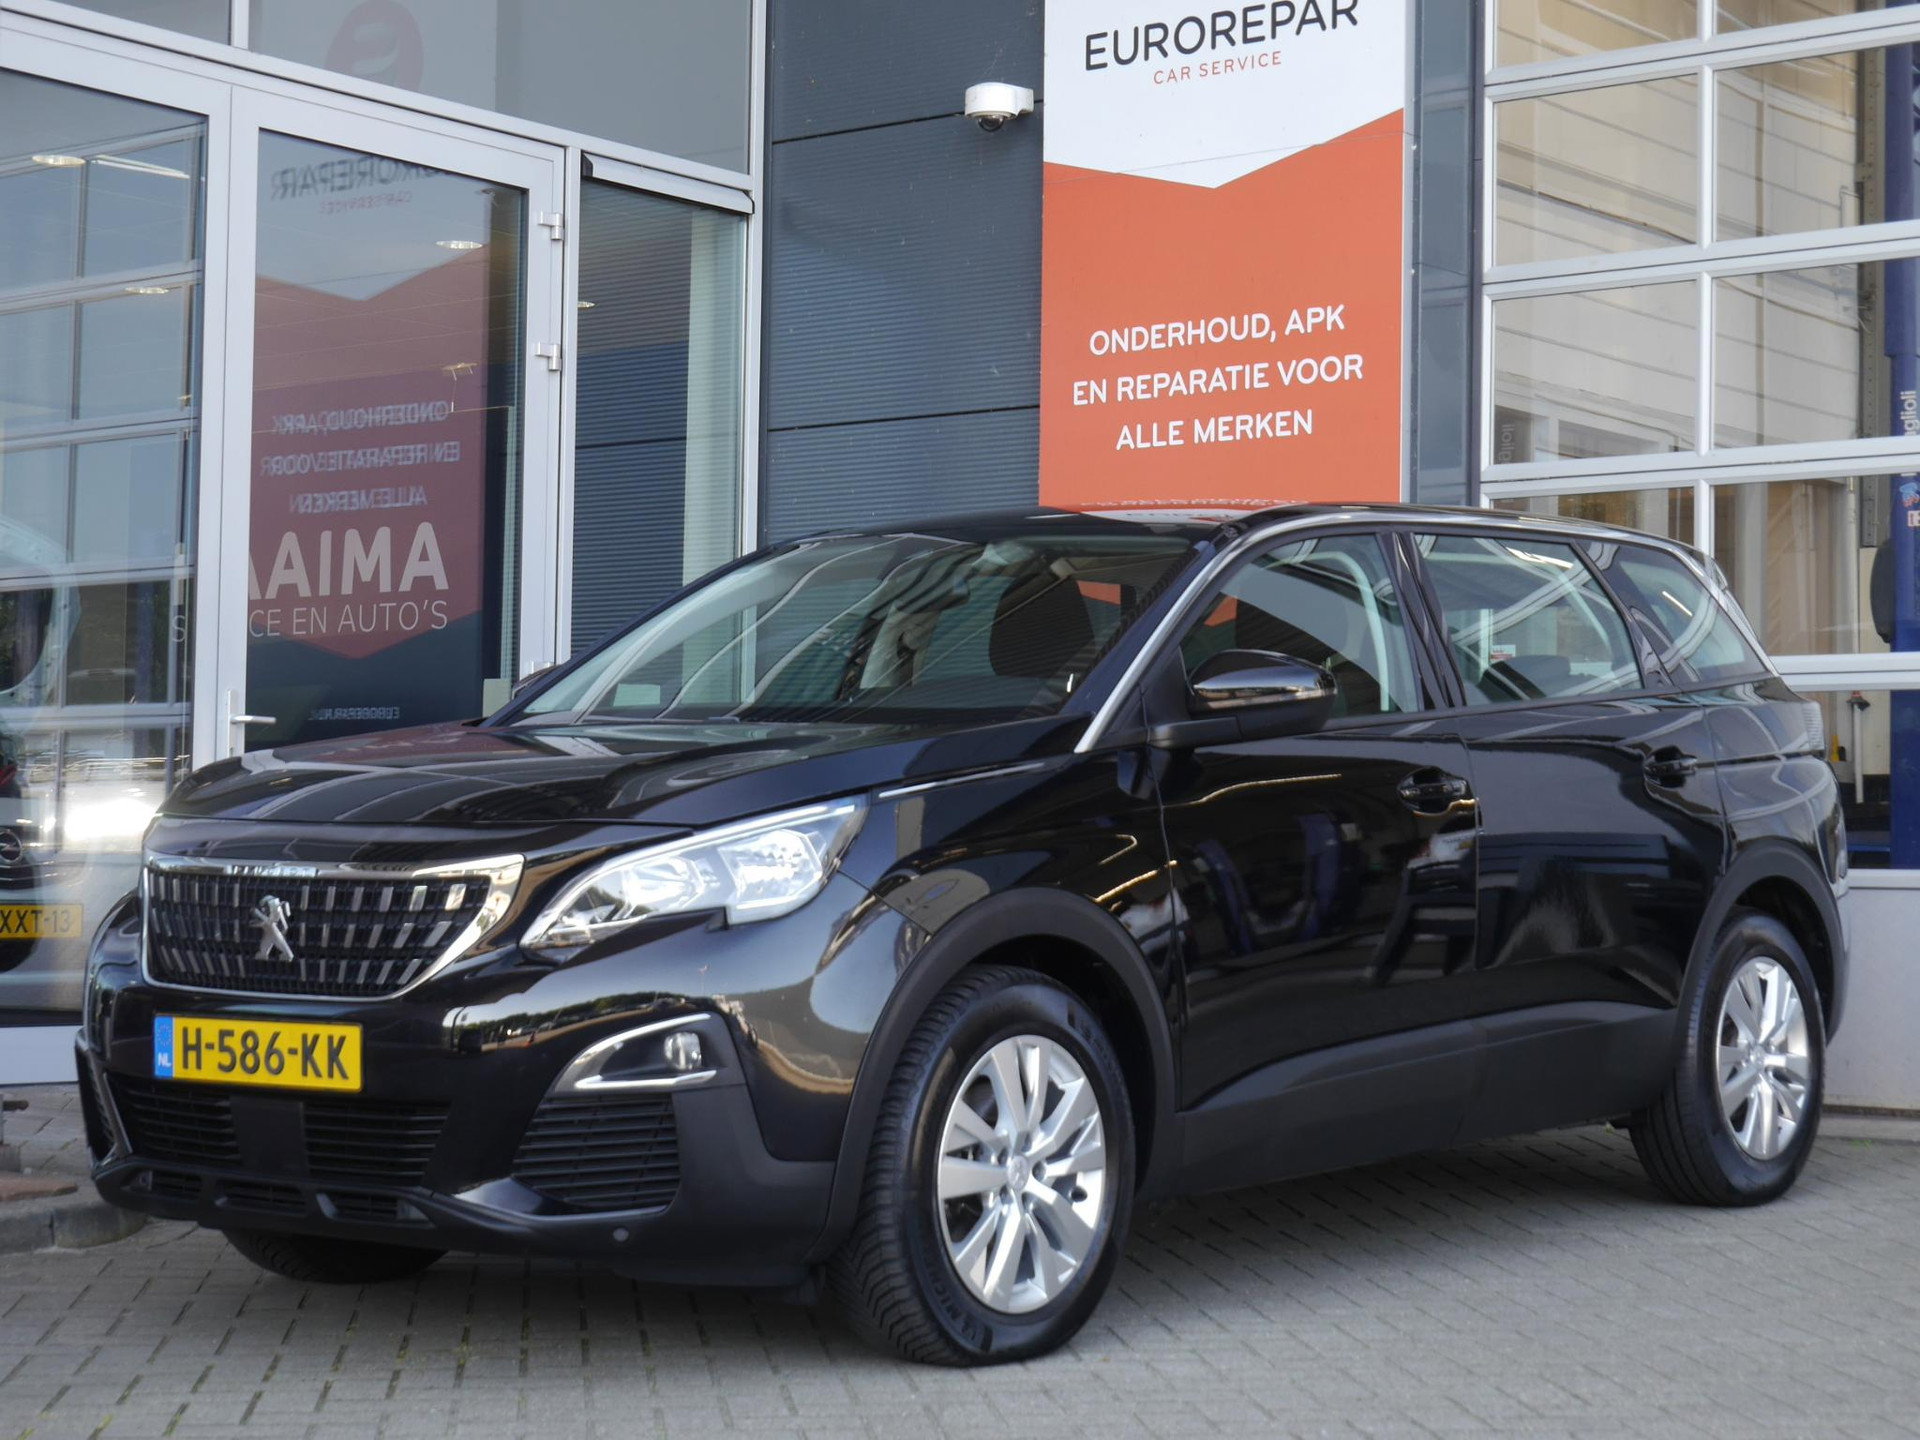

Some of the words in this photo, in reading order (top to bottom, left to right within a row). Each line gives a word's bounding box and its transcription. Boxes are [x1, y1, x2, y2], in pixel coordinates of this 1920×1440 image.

[1085, 0, 1358, 71] EUROREPAR
[1153, 66, 1191, 85] CAR
[1199, 51, 1282, 77] SERVICE
[1089, 311, 1278, 355] ONDERHOUD,
[1285, 304, 1346, 336] APK
[1073, 378, 1107, 405] EN
[1117, 362, 1269, 401] REPARATIE
[1277, 354, 1364, 385] VOOR
[1115, 420, 1184, 450] ALLE
[1193, 409, 1313, 444] MERKEN
[292, 606, 328, 635] EN
[337, 599, 449, 633] AUTO'S
[157, 1052, 172, 1068] NL
[182, 1026, 349, 1080] H-586-KK
